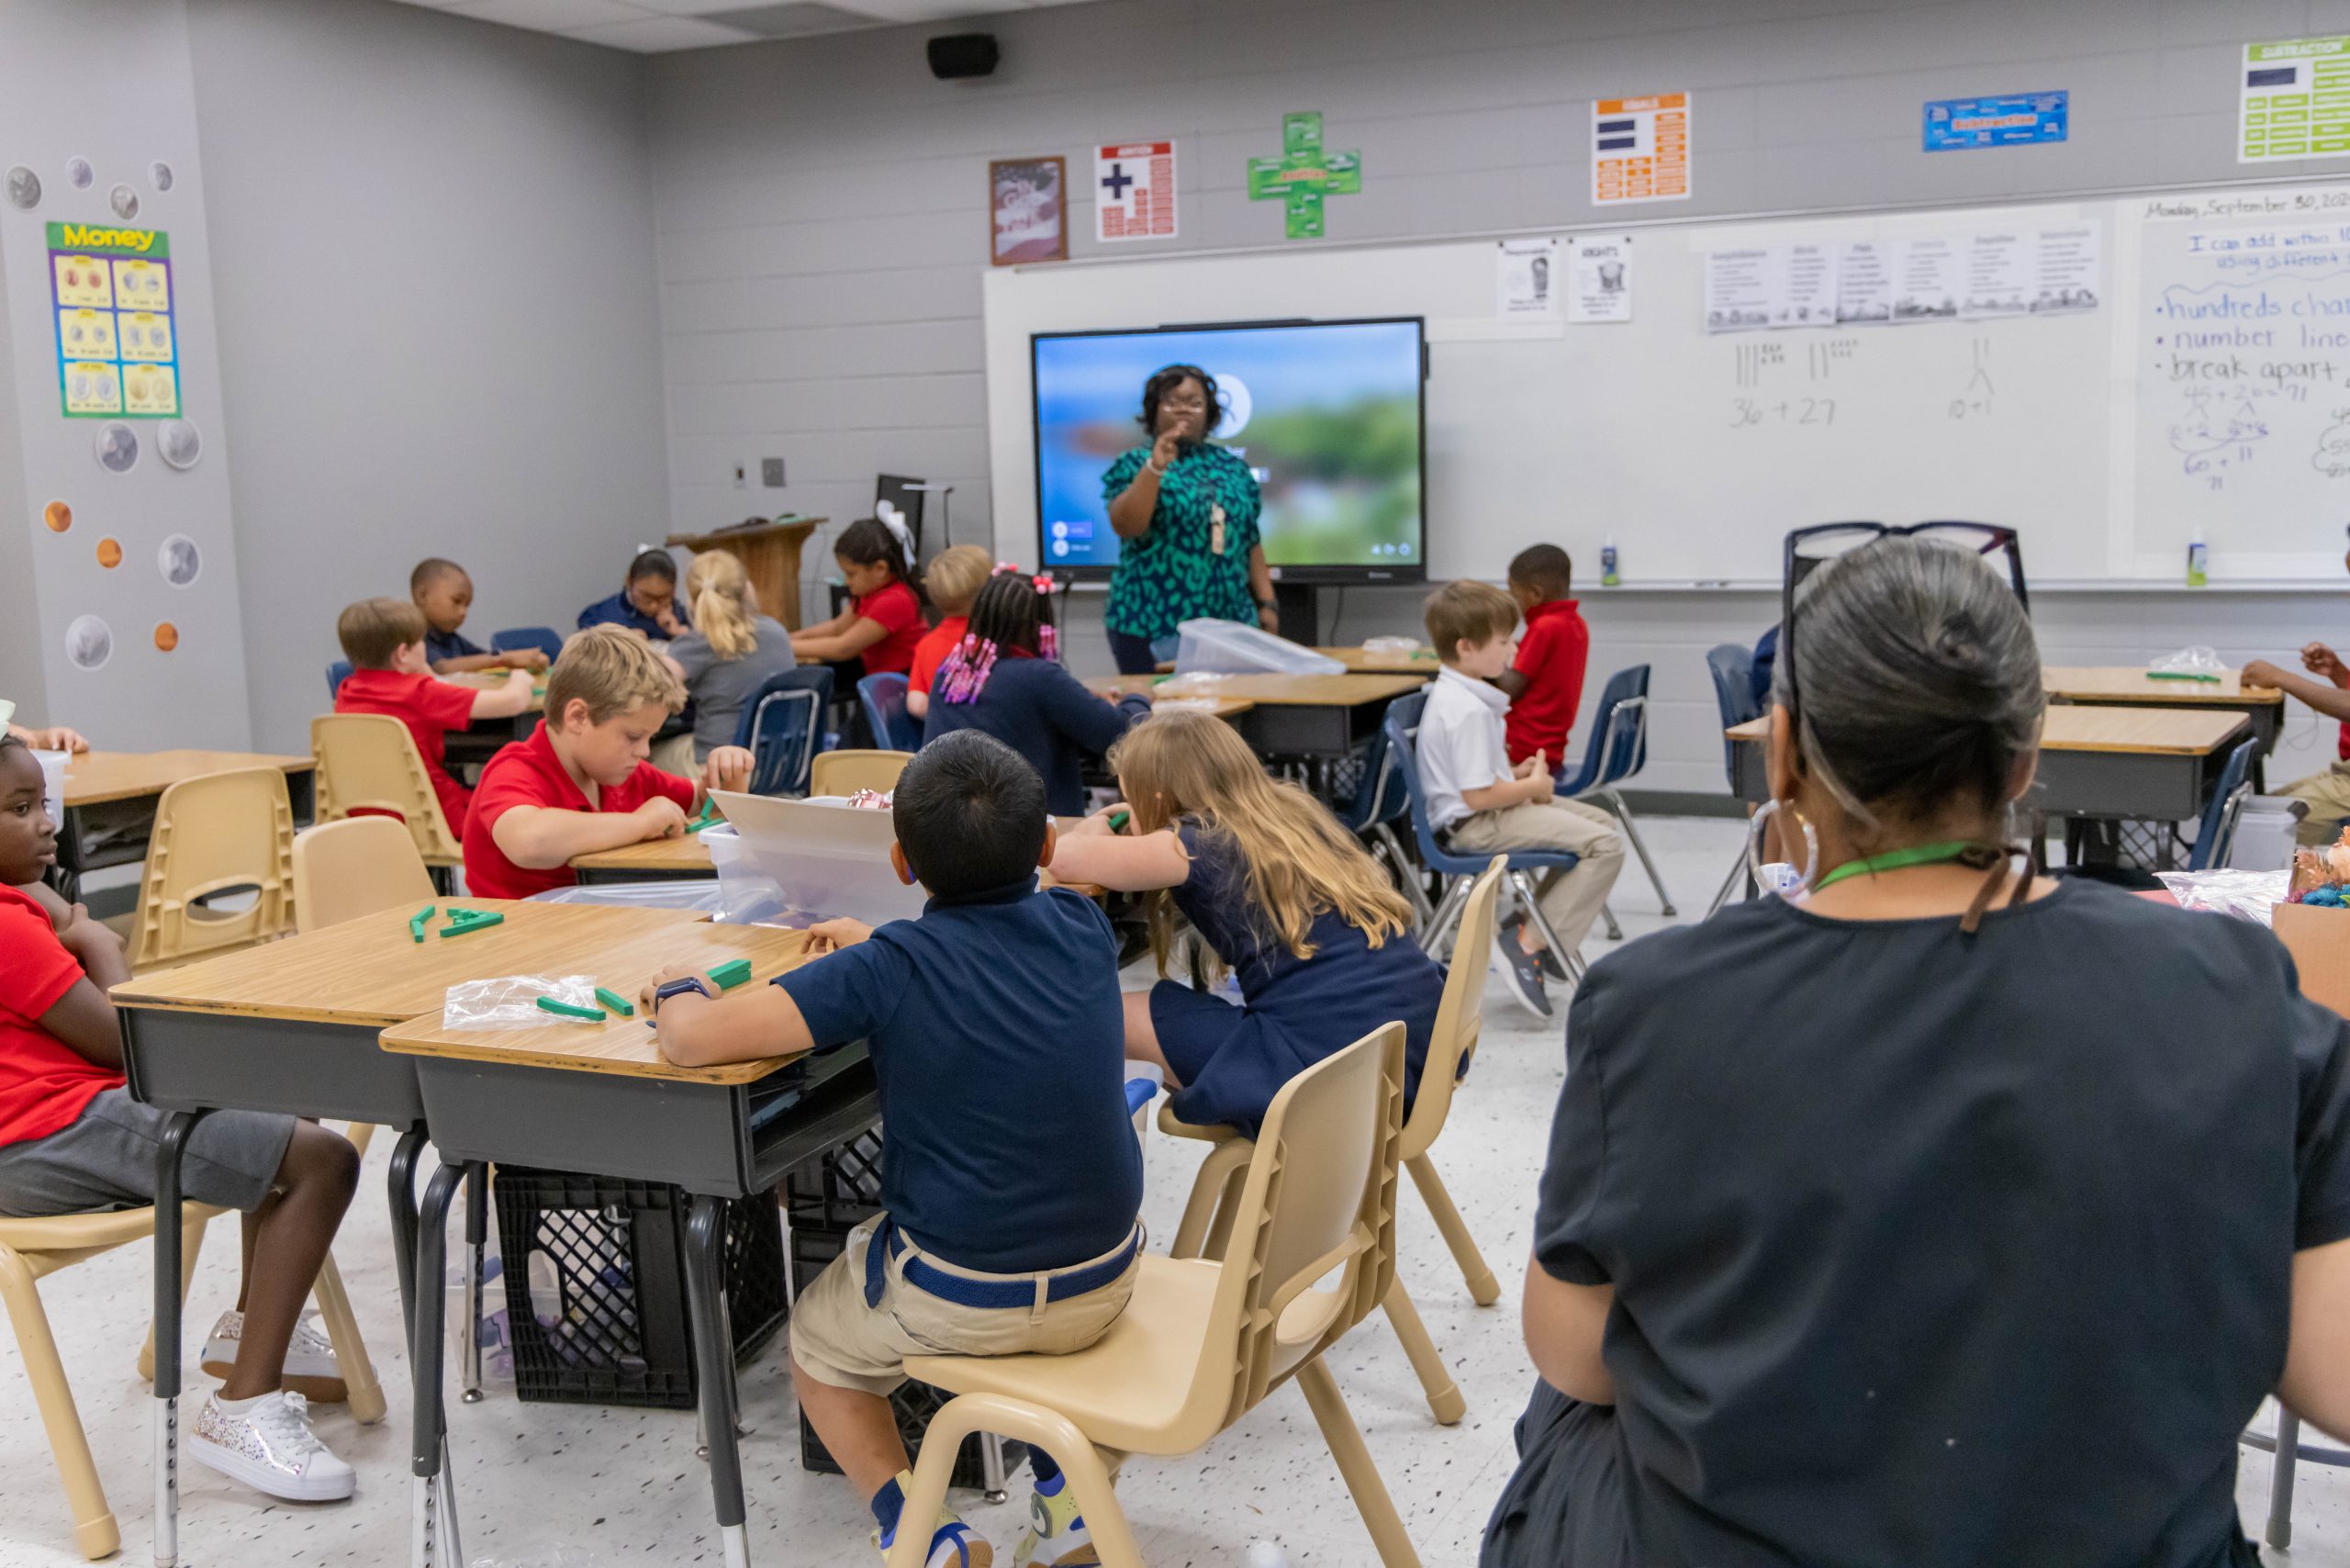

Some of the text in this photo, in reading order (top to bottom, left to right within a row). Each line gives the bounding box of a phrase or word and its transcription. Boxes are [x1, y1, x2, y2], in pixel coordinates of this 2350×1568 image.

[1953, 115, 2037, 130] Subtraction
[2208, 196, 2286, 218] September
[2322, 191, 2350, 208] 202
[63, 224, 154, 252] Money
[2210, 239, 2240, 251] can
[2245, 232, 2276, 248] add
[2216, 252, 2338, 276] using different
[2165, 292, 2282, 319] hundreds
[2176, 325, 2275, 349] number
[2169, 353, 2338, 389] break apart
[1729, 397, 1763, 429] 36
[1798, 397, 1836, 425] 27
